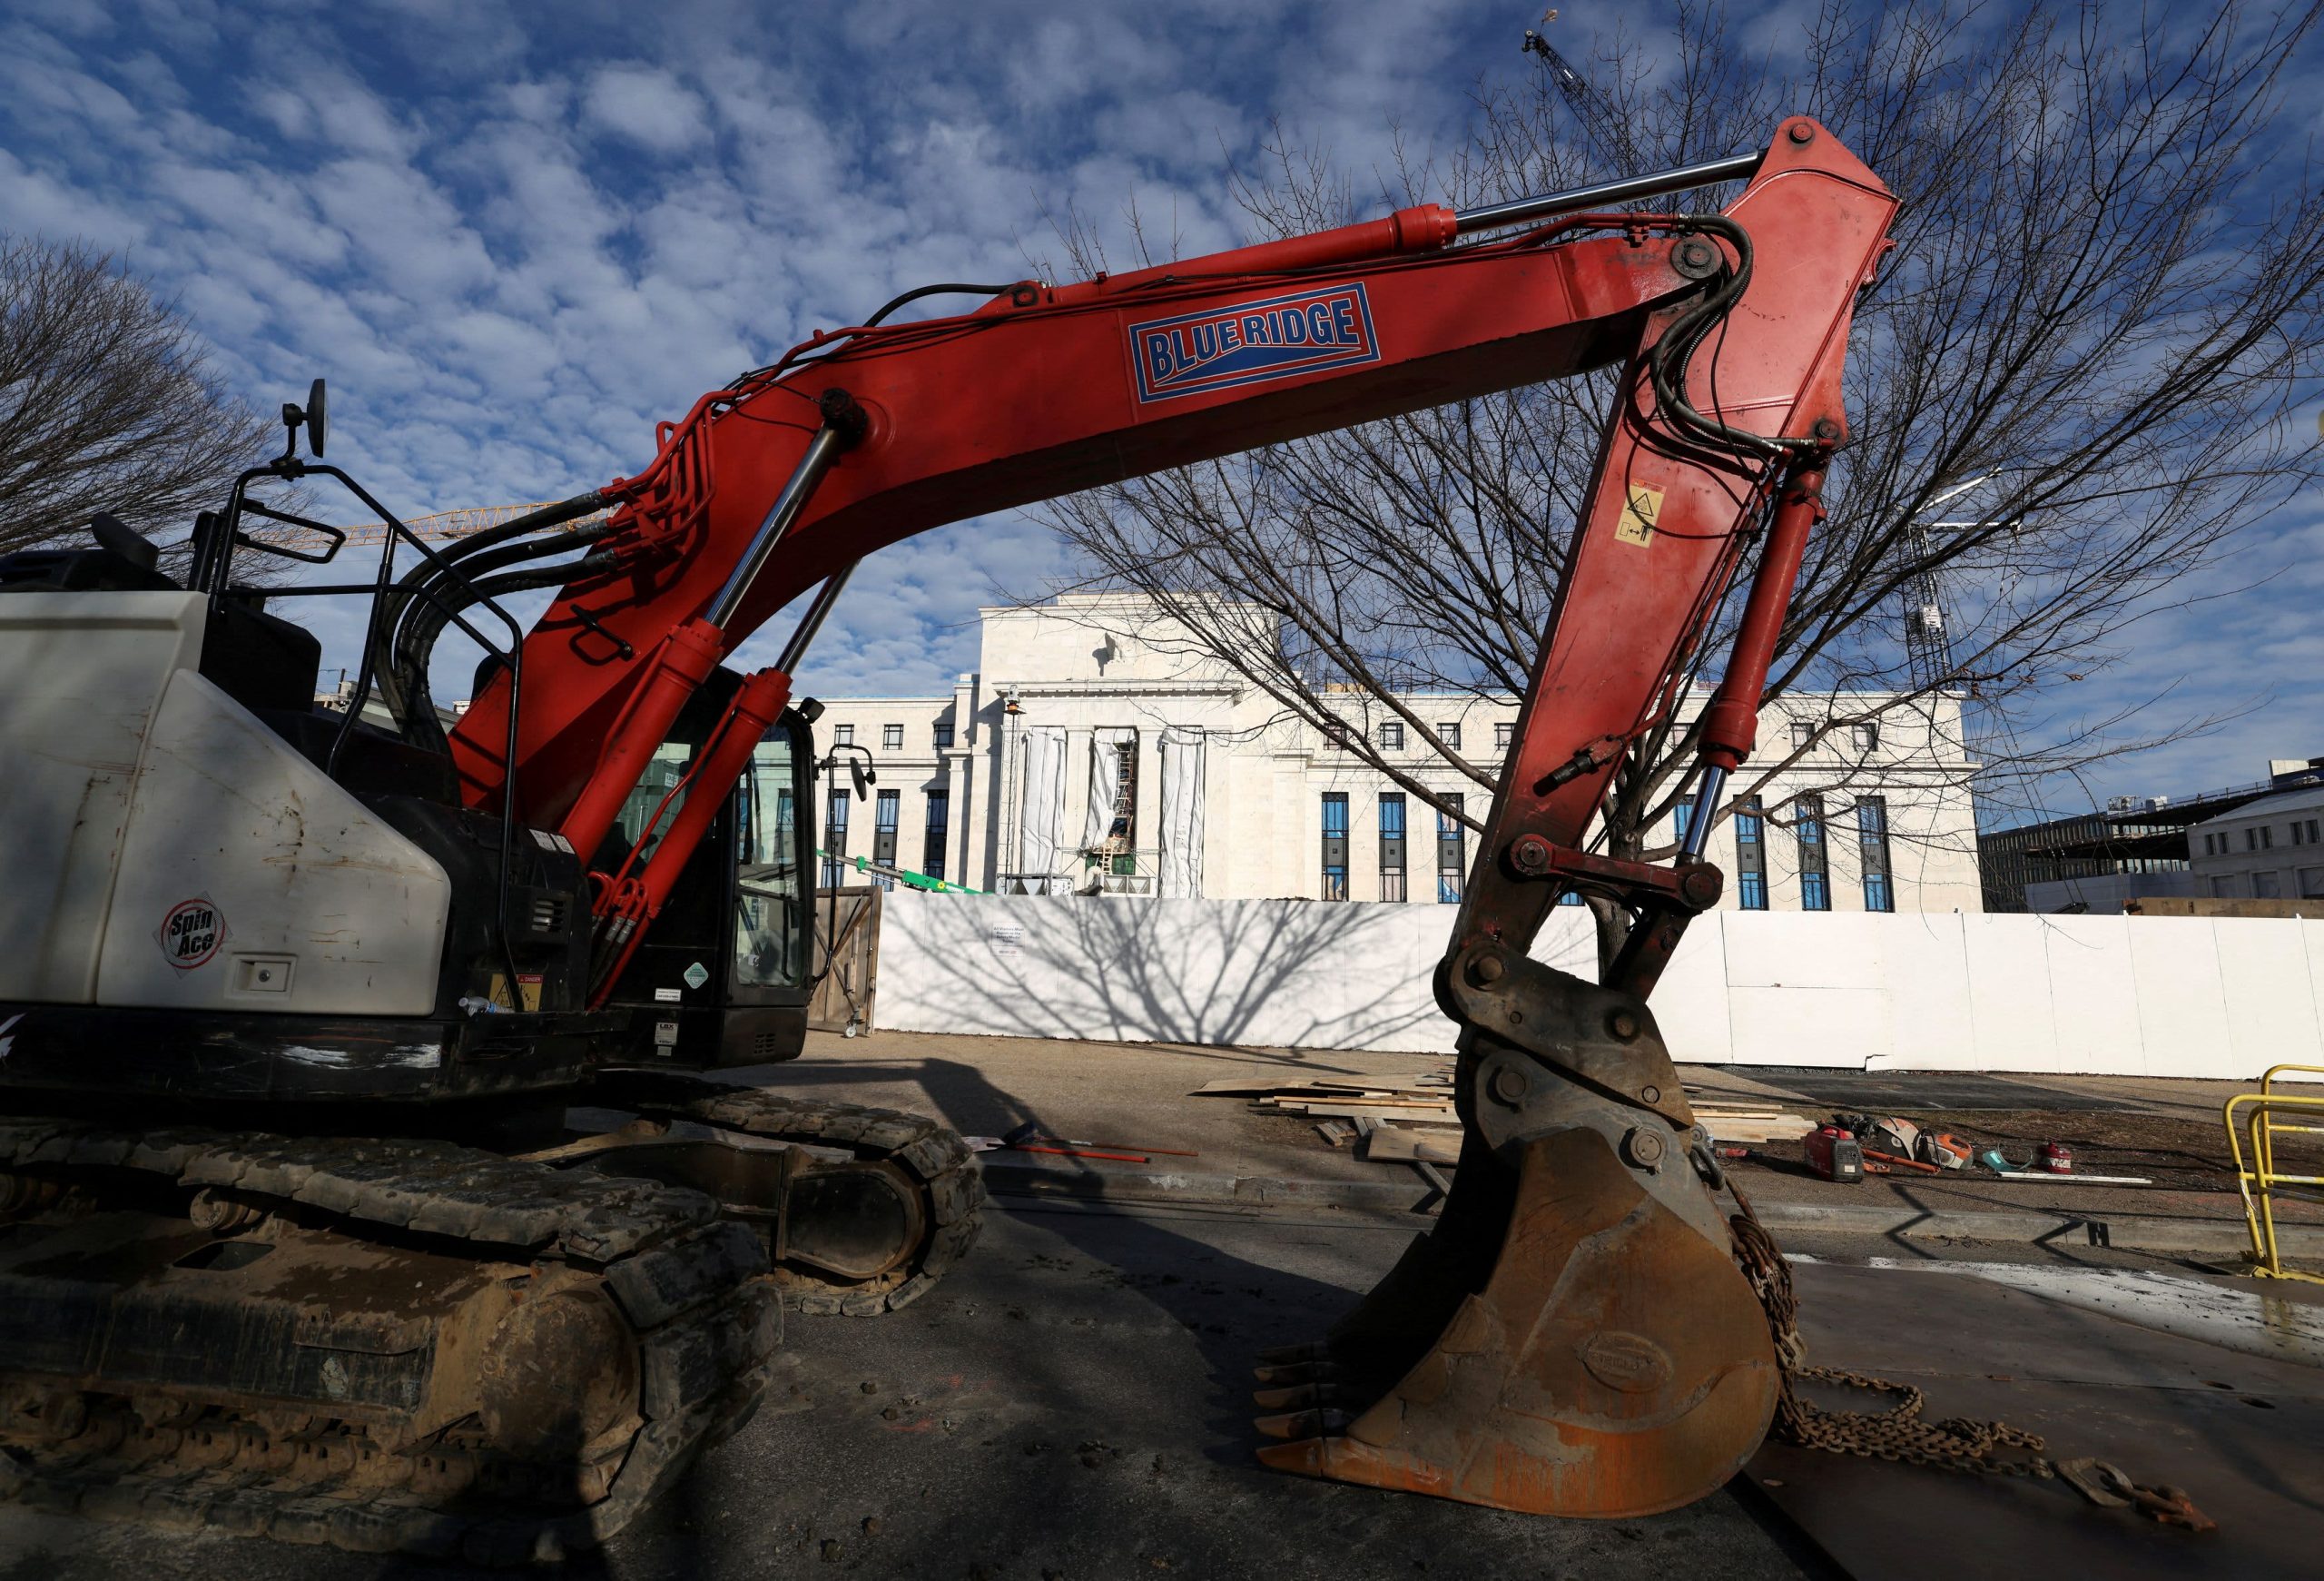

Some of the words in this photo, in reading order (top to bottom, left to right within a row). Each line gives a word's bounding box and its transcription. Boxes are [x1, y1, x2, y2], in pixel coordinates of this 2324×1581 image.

[1147, 320, 1241, 382] BLUE
[1242, 298, 1360, 345] RIDGE
[171, 909, 213, 936] Spin
[177, 933, 215, 957] Ace
